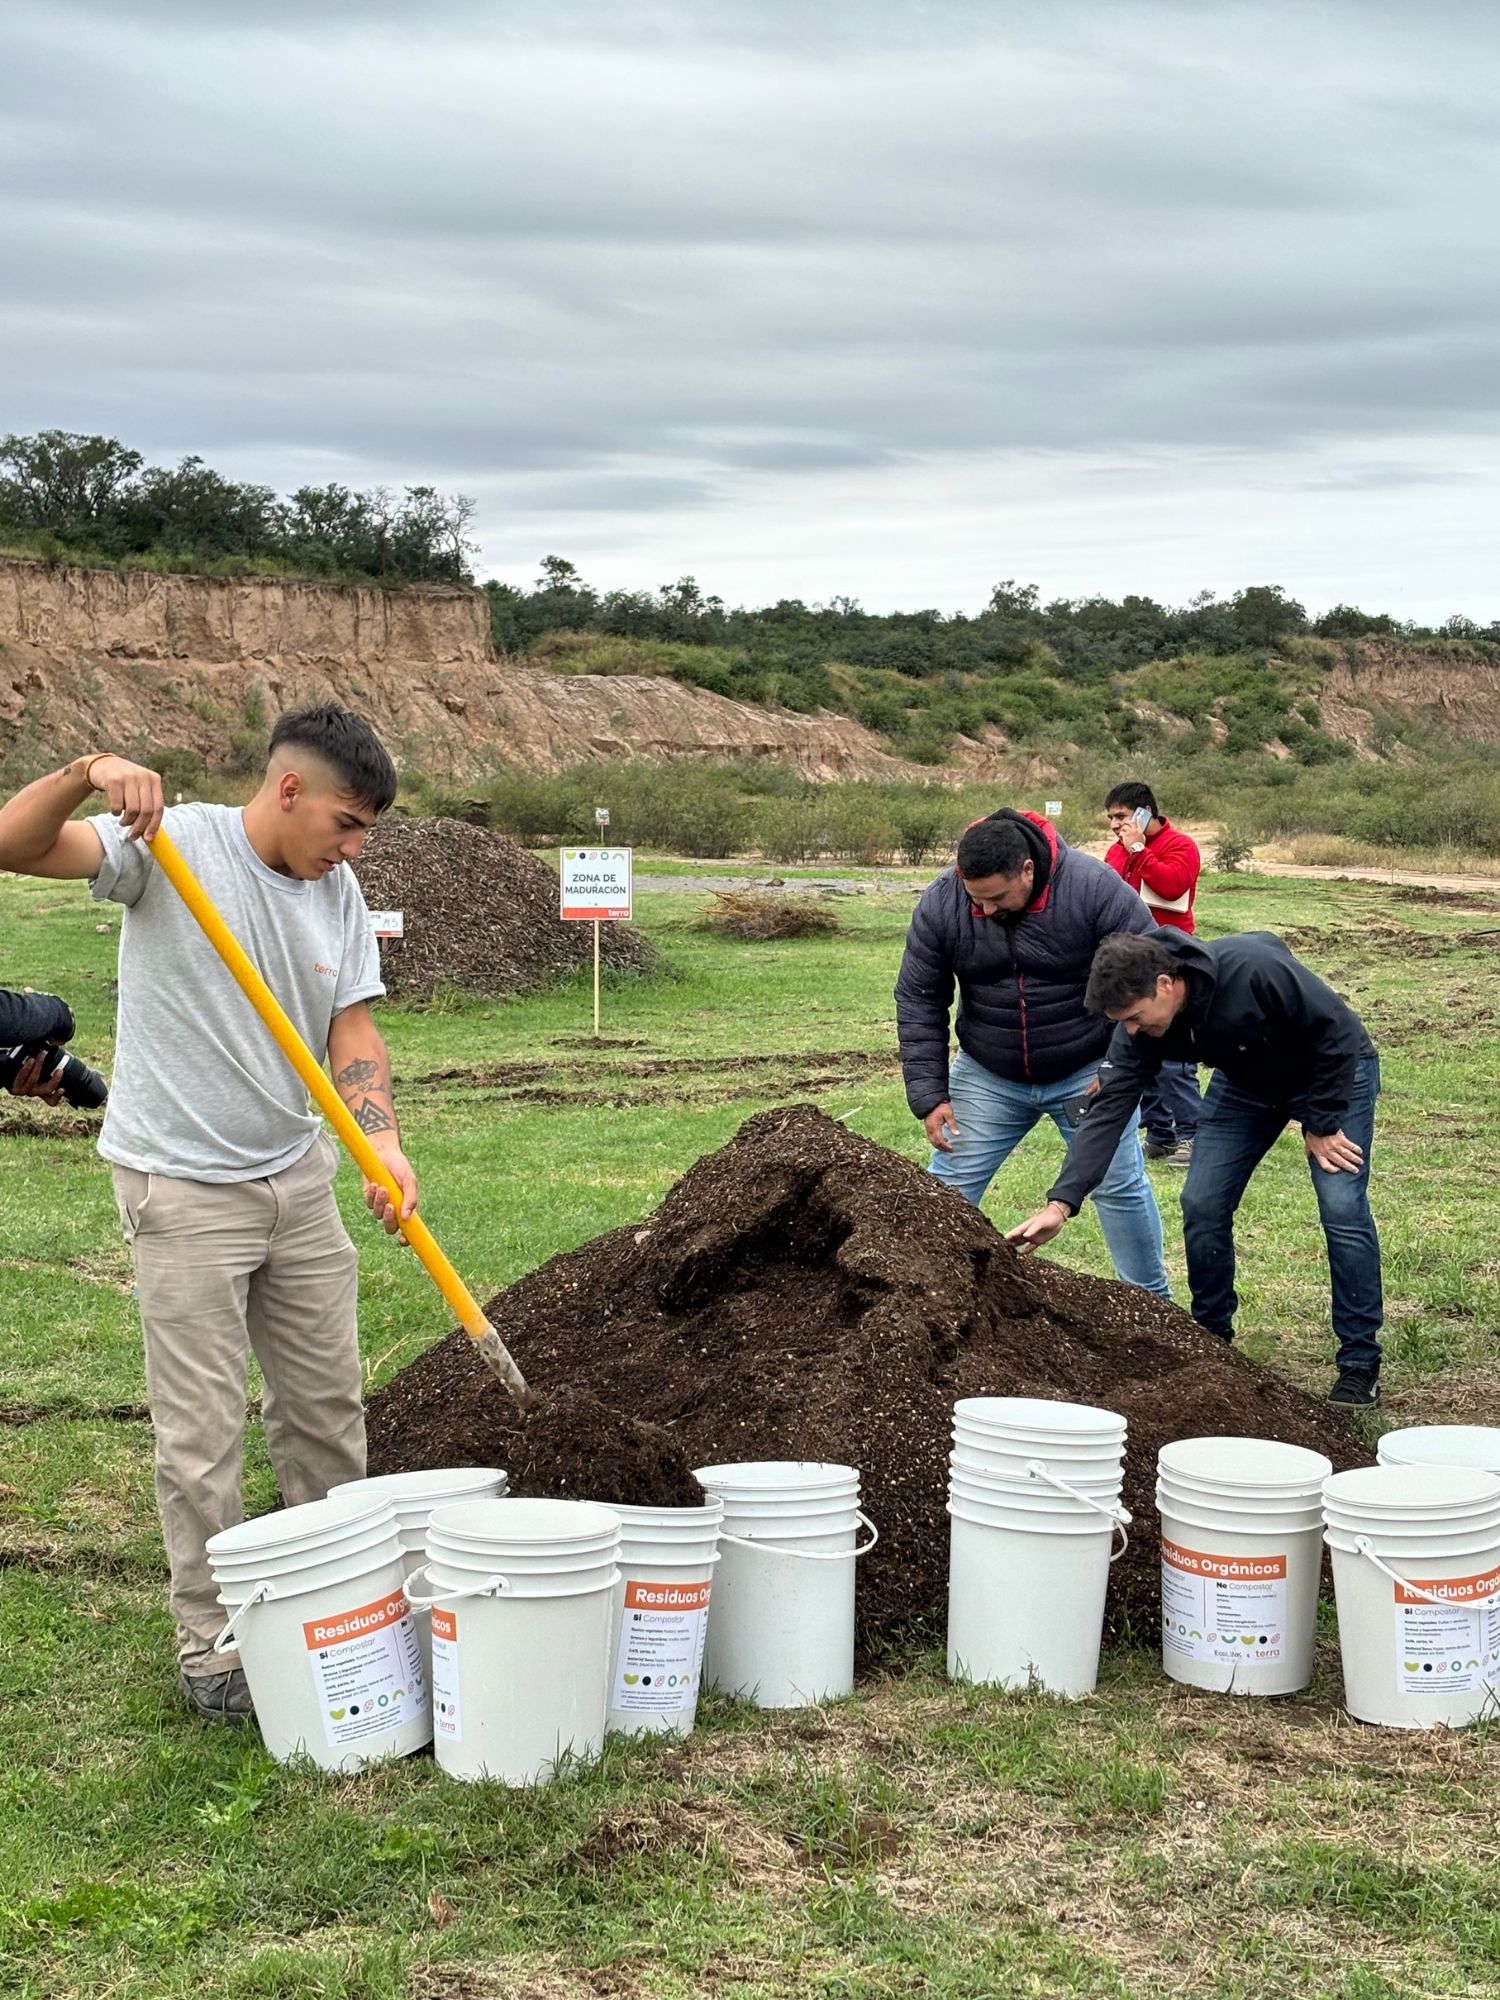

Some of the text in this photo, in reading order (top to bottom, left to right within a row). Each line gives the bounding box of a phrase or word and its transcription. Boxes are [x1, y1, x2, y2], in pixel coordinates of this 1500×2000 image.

[572, 874, 616, 882] ZONA DE
[565, 884, 626, 894] MADURACIÓN
[608, 909, 629, 917] terra
[314, 962, 337, 977] terra
[1201, 1559, 1281, 1576] Orgánicos
[1229, 1583, 1273, 1591] Compostar
[635, 1588, 698, 1604] Residuos
[1414, 1608, 1460, 1617] Compostar
[643, 1614, 686, 1625] Compostar
[313, 1610, 385, 1642] Residuos
[329, 1637, 376, 1658] Compostar
[1255, 1649, 1280, 1658] terra
